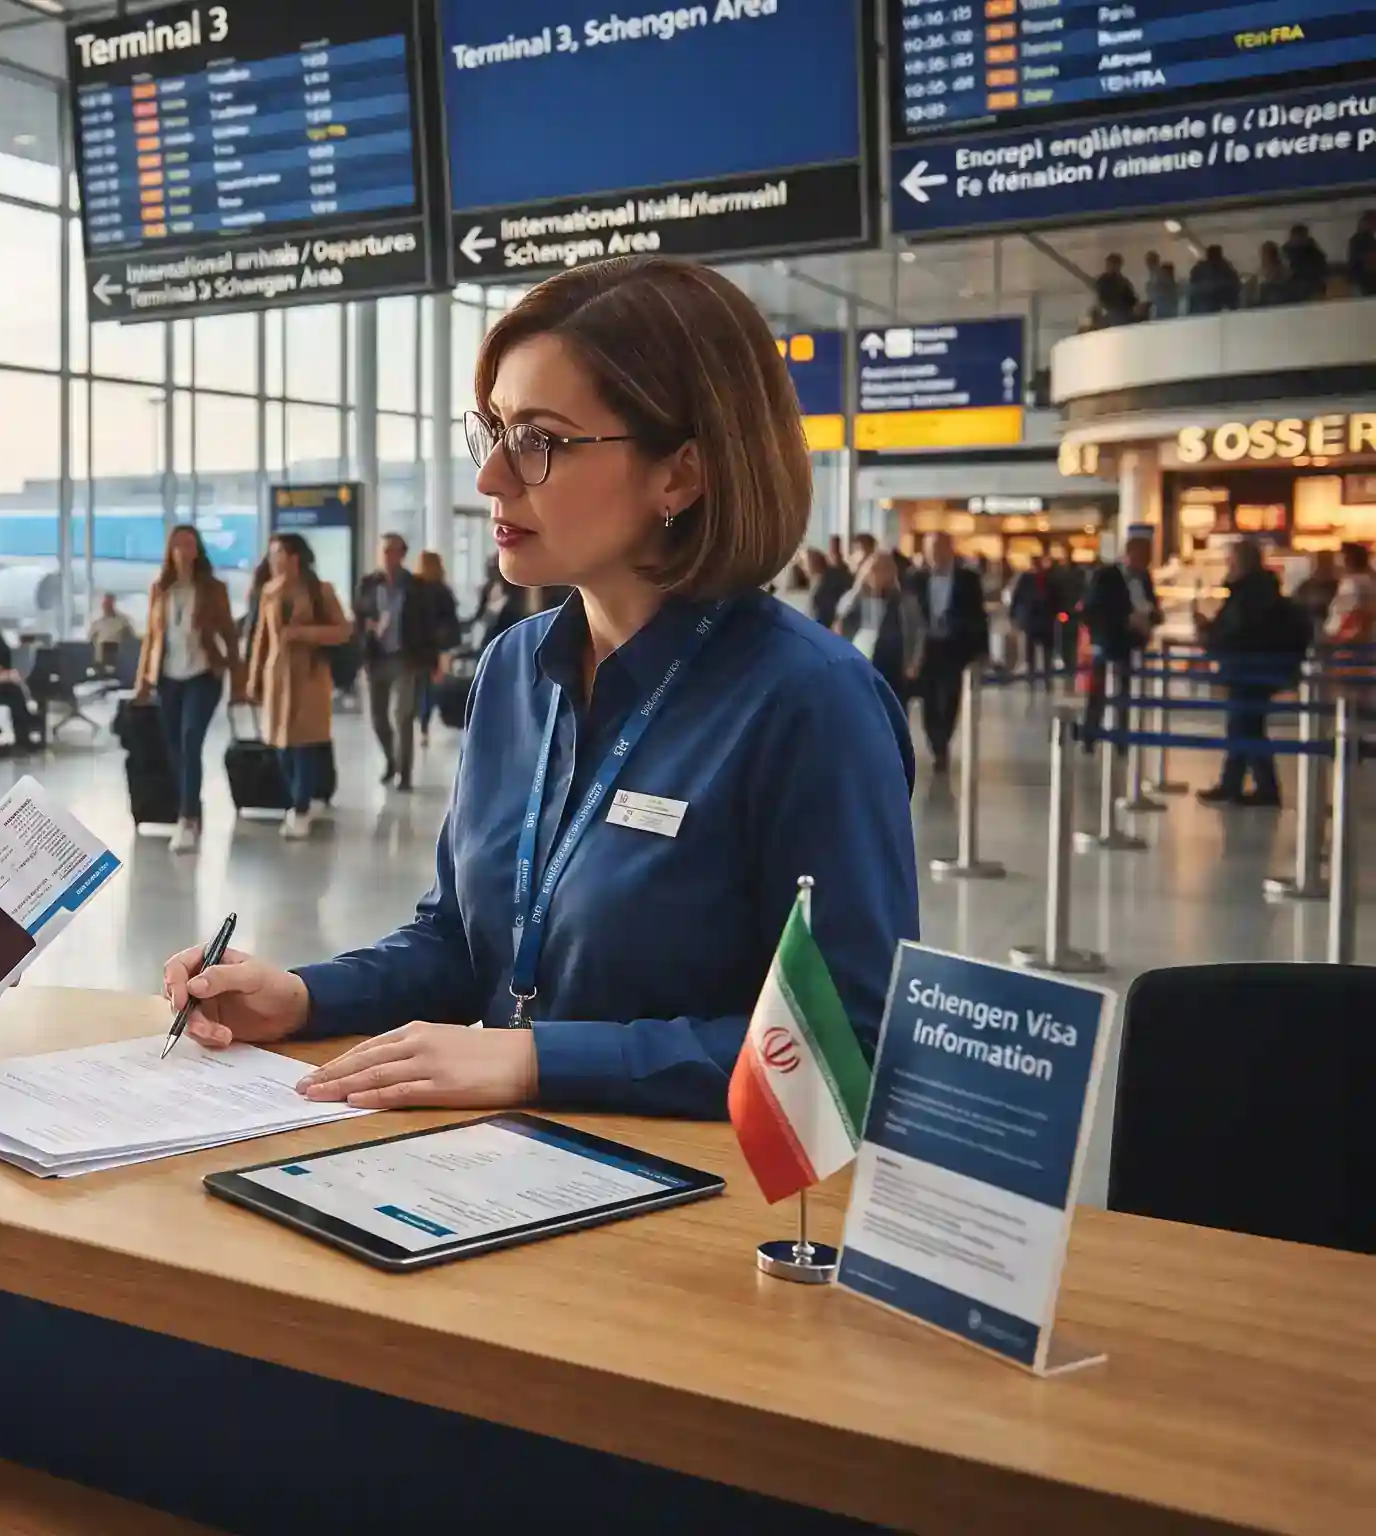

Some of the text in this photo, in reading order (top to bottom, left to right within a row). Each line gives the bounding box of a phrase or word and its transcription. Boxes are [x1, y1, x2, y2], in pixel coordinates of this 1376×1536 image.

[74, 6, 229, 67] Terminal 3
[451, 0, 778, 70] Terminal 3, Schengen Area
[1097, 157, 1108, 180] /
[1207, 140, 1219, 166] /
[608, 230, 661, 254] Area
[906, 978, 1077, 1047] Schengen Visa
[912, 1017, 1053, 1081] Information
